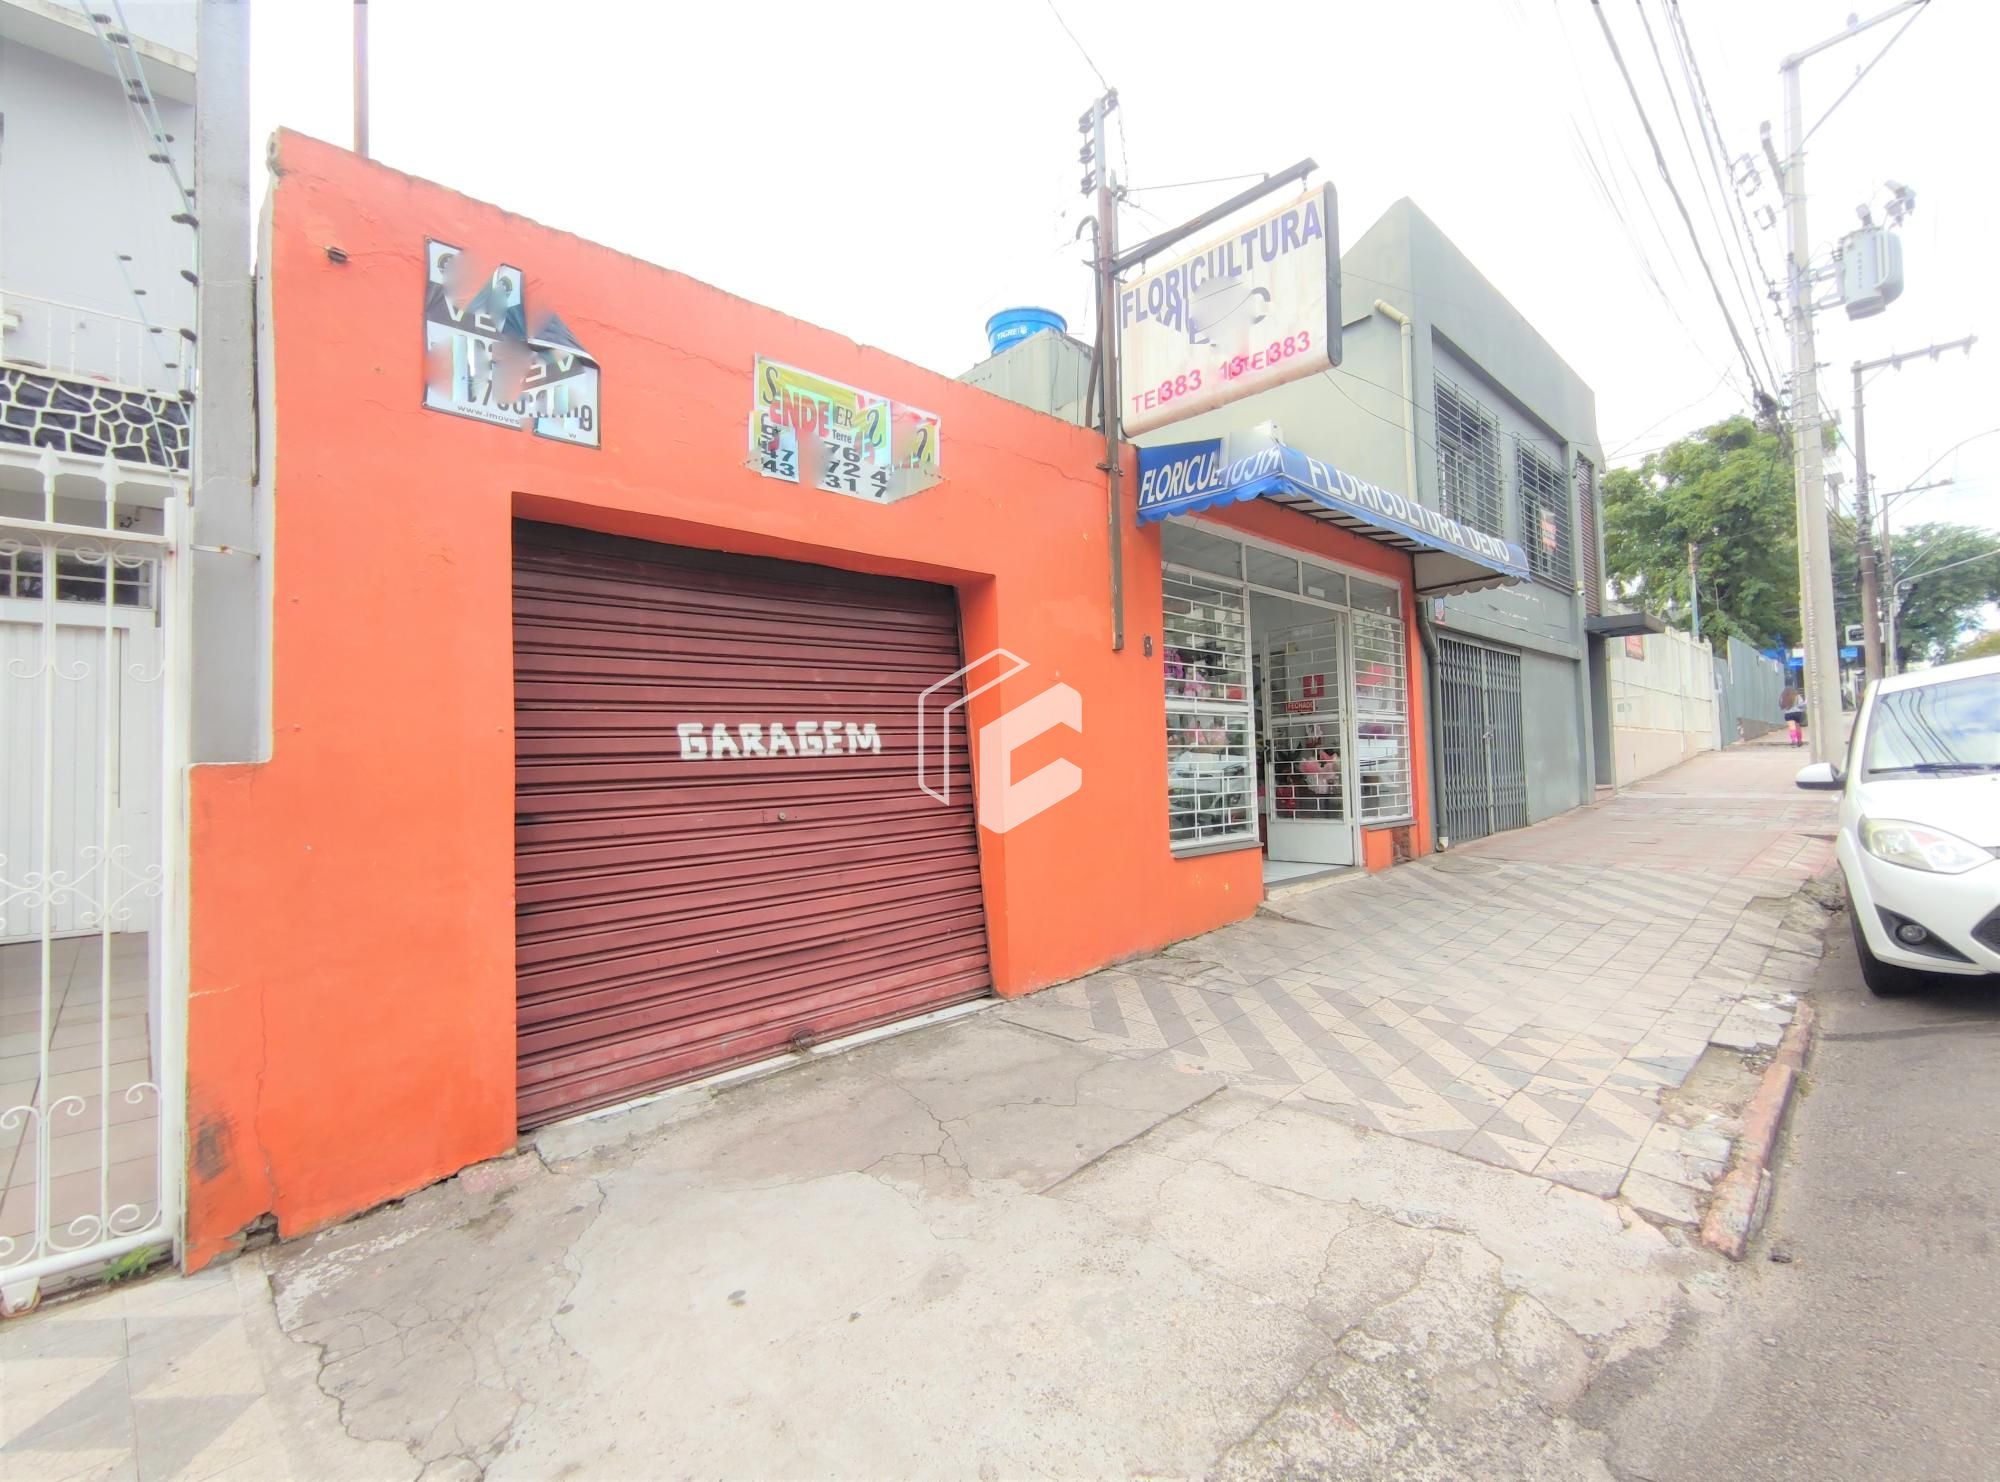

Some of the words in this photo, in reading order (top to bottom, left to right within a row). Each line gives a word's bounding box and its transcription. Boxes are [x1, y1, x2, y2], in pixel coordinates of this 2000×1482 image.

[1121, 199, 1323, 330] FLORICULTURA
[1306, 455, 1465, 546] FLORICULTURA
[677, 720, 882, 760] GARAGEM
